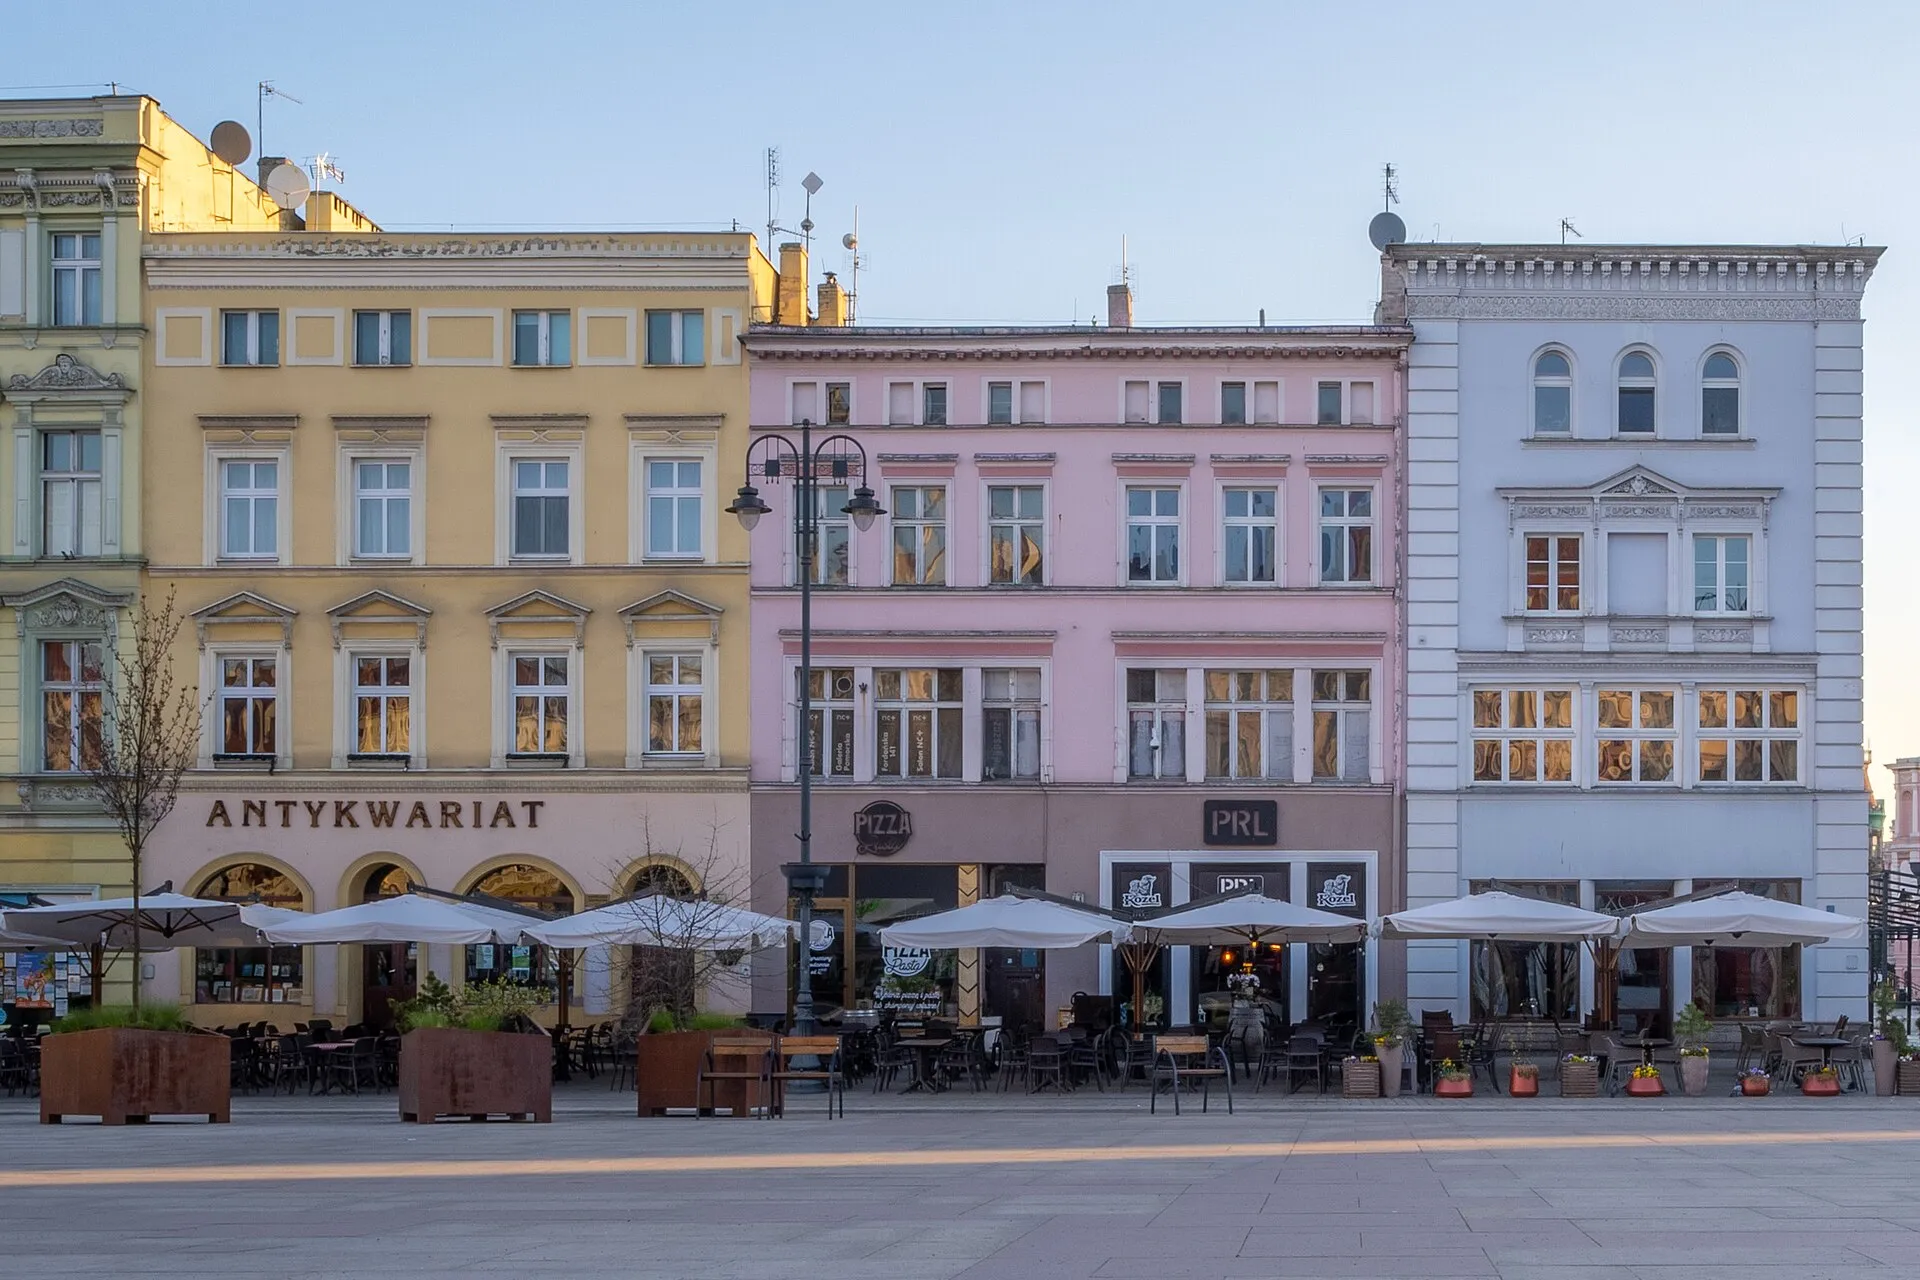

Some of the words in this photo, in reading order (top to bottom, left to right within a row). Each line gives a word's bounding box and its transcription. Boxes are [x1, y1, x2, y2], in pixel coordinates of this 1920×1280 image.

[835, 742, 843, 772] Galeria
[206, 799, 545, 828] ANTYKWARIAT
[855, 813, 911, 835] PIZZA
[1212, 810, 1269, 836] PRL
[1220, 878, 1255, 893] PR
[1123, 893, 1161, 906] Kozel
[1318, 893, 1355, 906] Kozel
[888, 958, 921, 972] Pasta
